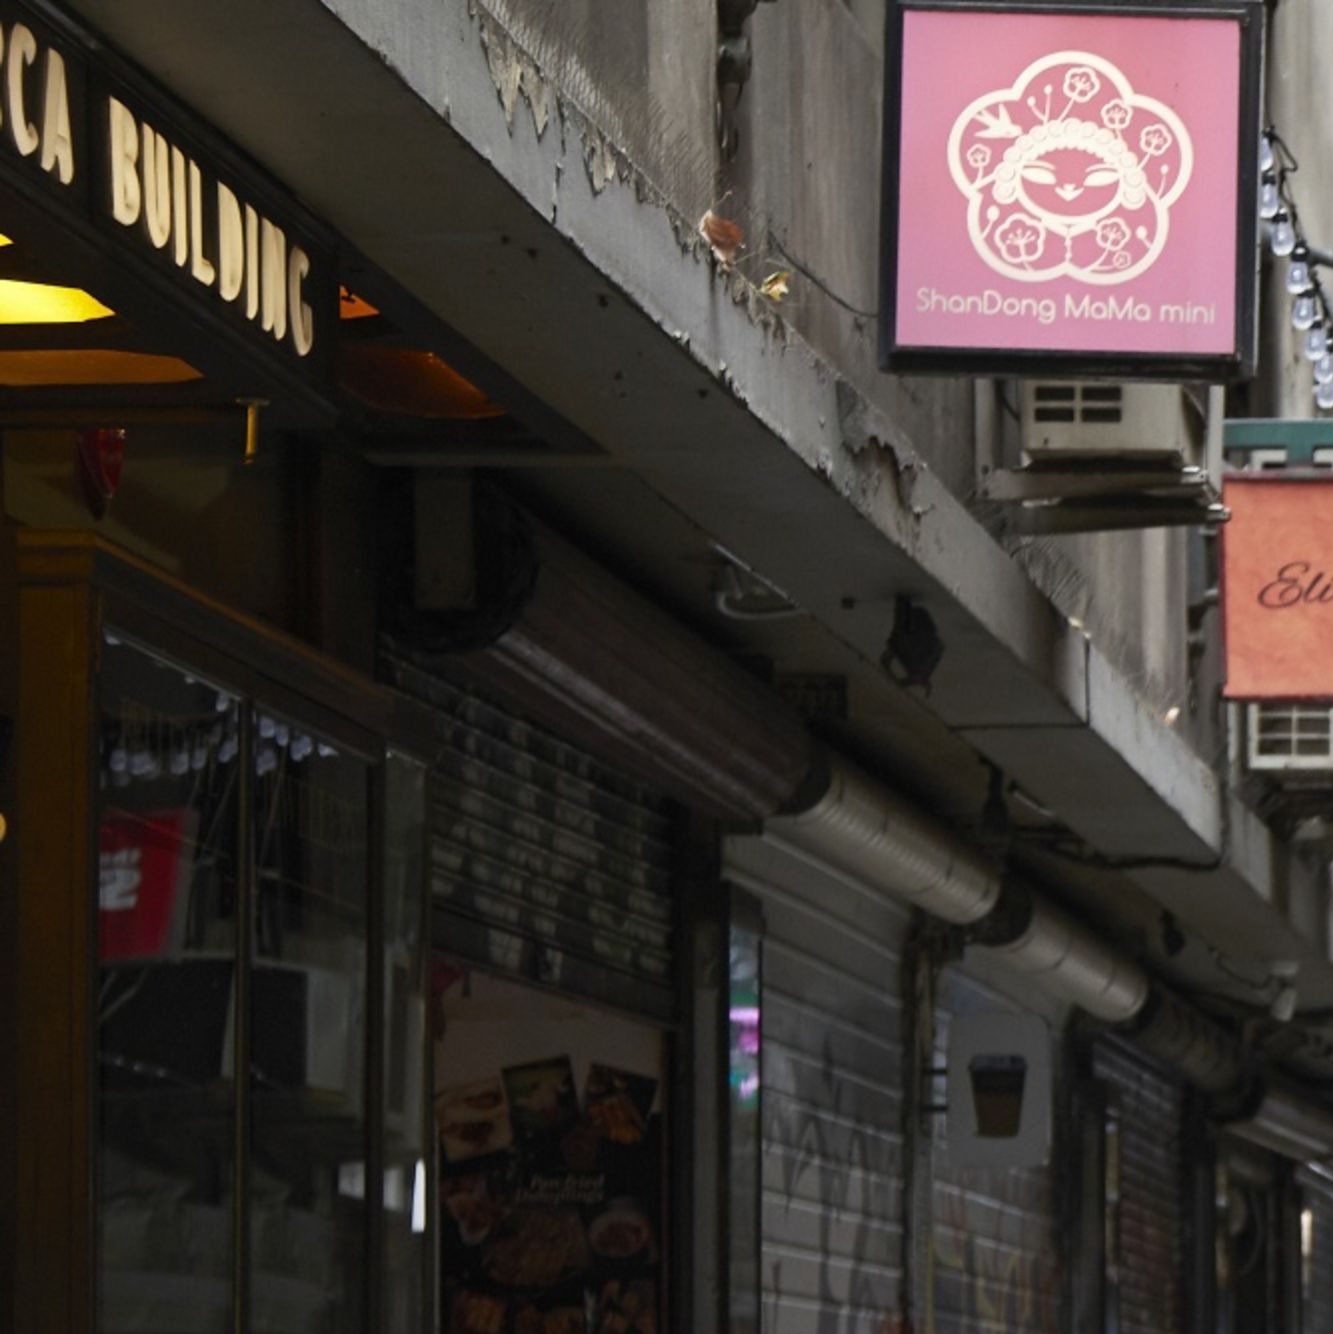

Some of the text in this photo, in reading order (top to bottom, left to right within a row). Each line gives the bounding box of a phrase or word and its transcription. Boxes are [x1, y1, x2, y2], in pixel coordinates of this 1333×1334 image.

[0, 22, 315, 358] CA BUILDING
[914, 286, 1217, 326] ShanDong MaMa mini
